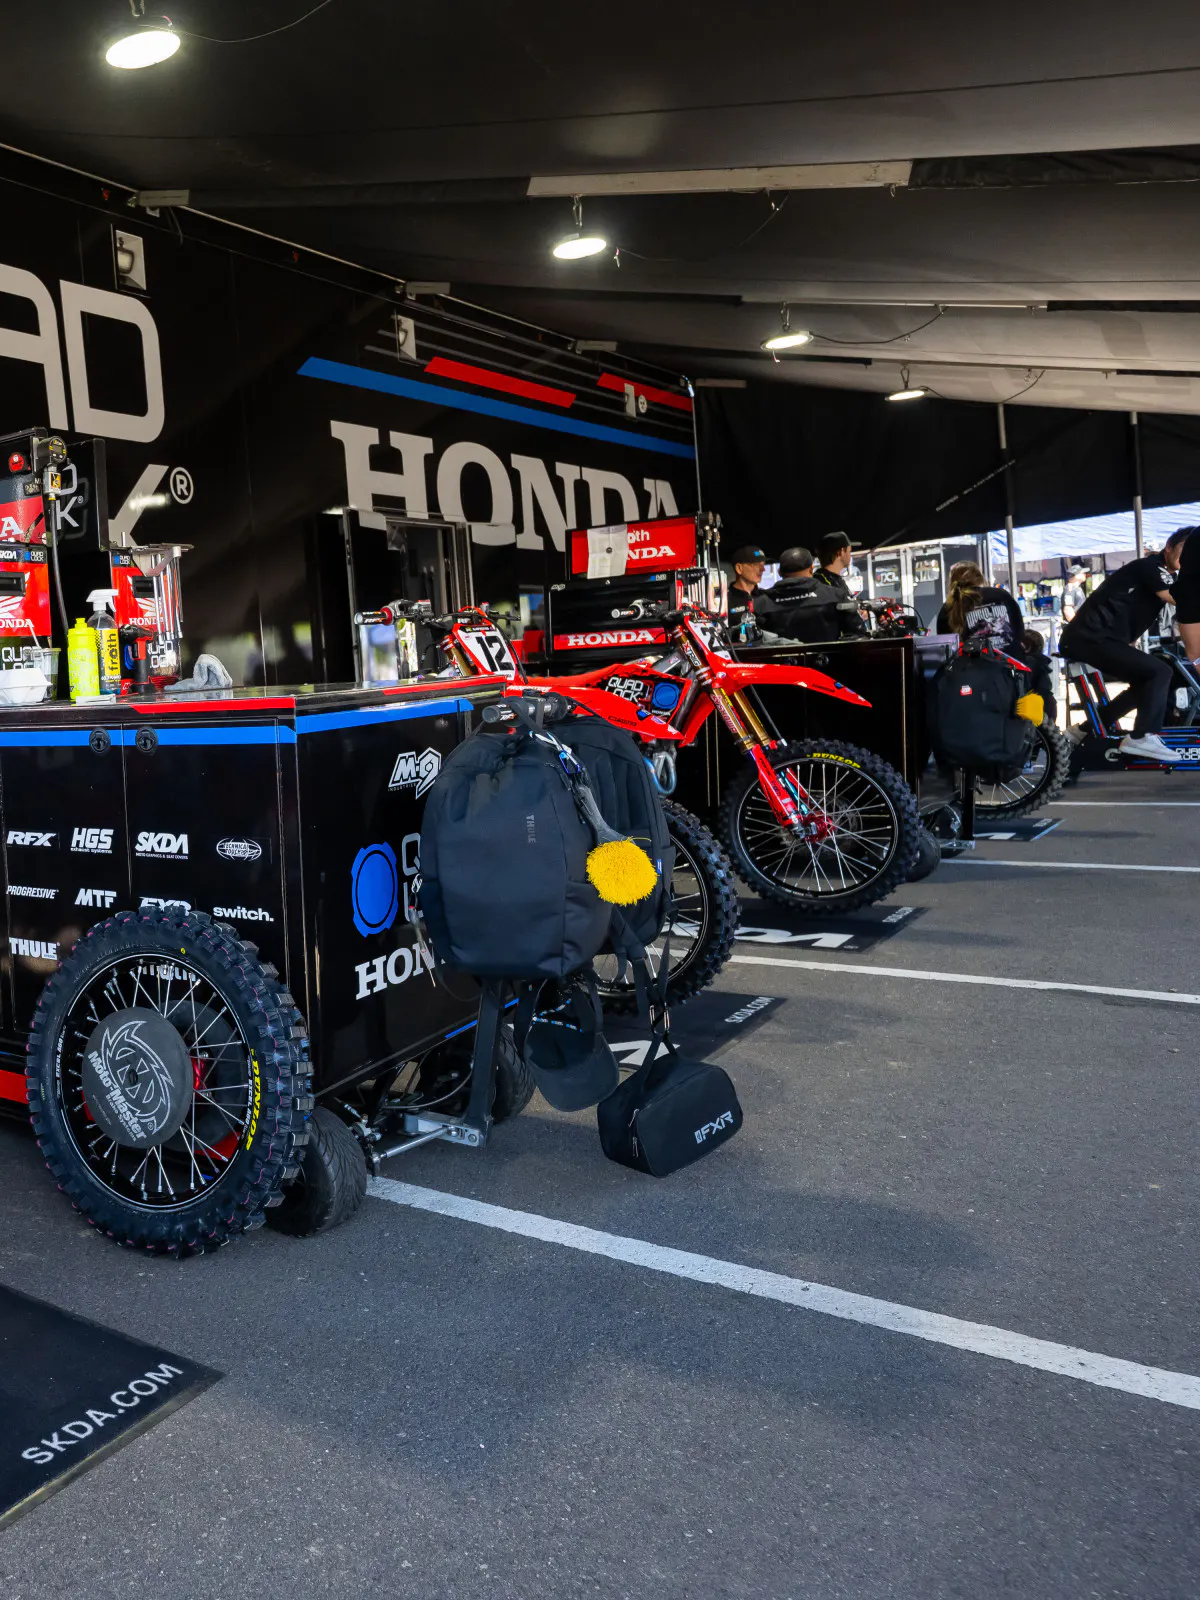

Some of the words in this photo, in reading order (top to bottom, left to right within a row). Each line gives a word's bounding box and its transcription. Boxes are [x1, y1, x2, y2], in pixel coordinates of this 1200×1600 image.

[330, 420, 682, 552] HONDA
[627, 545, 676, 561] NDA
[567, 630, 655, 647] HONDA
[107, 633, 117, 672] froth
[475, 635, 515, 672] 12
[607, 676, 644, 692] QUAD
[812, 751, 861, 769] DUNLOP
[6, 830, 57, 847] RFX
[71, 827, 115, 850] HGS
[525, 813, 537, 844] THULE
[135, 831, 189, 855] SKDA
[74, 888, 118, 909] MTF
[212, 905, 275, 923] switch.
[87, 1050, 148, 1139] Moto-Master
[246, 1060, 261, 1151] DUNLOP
[701, 1110, 735, 1141] FXR
[21, 1362, 184, 1454] SKDA.COM
